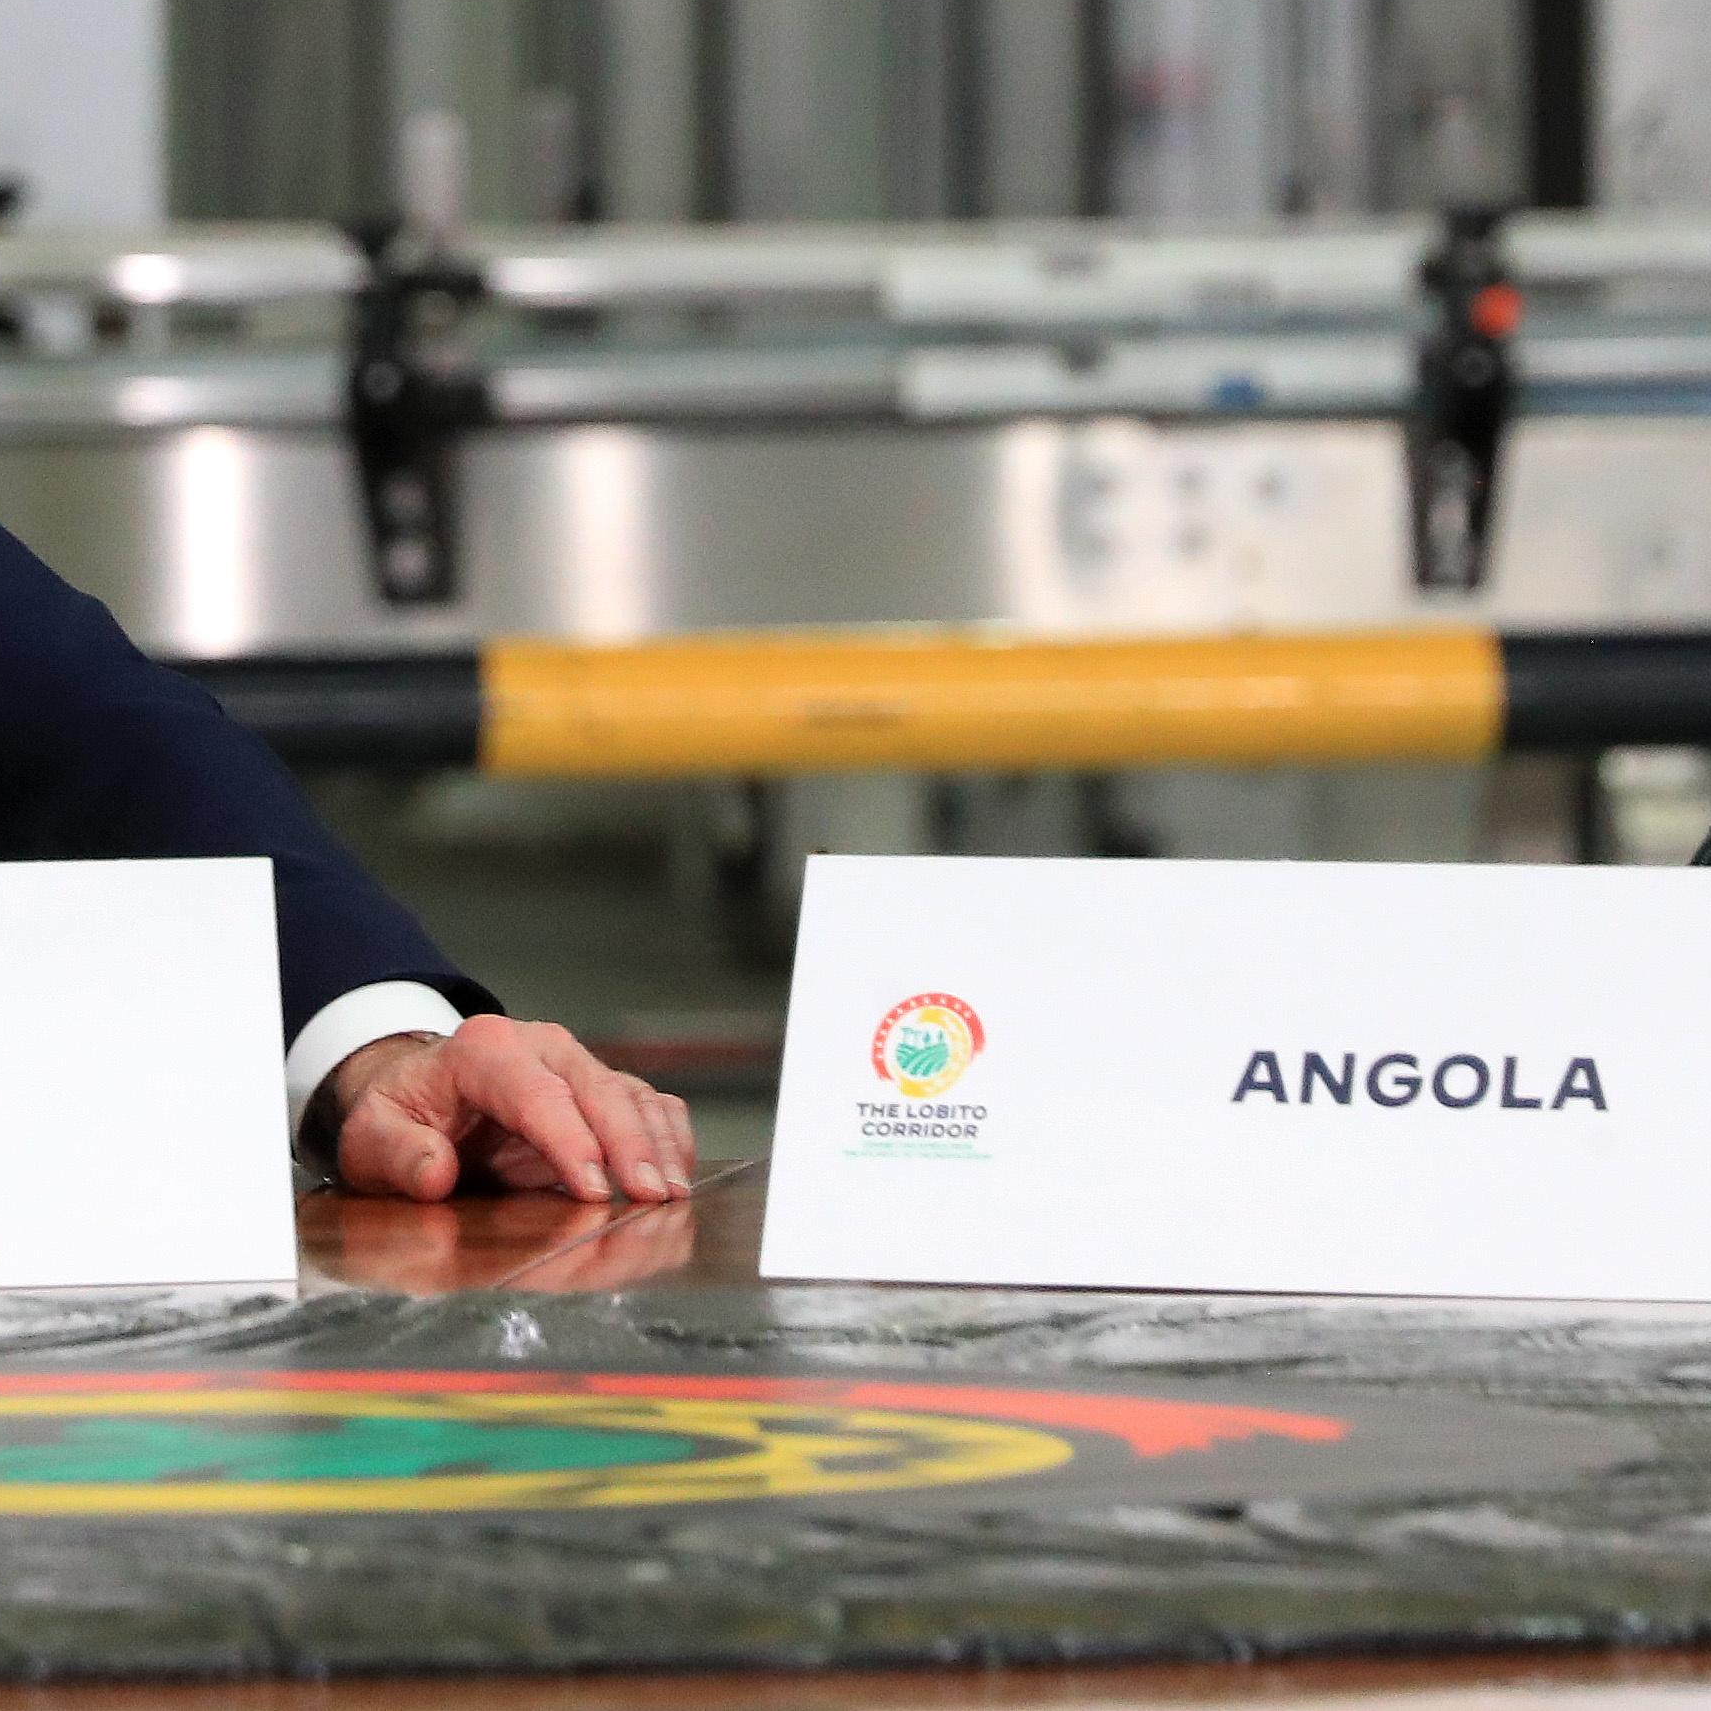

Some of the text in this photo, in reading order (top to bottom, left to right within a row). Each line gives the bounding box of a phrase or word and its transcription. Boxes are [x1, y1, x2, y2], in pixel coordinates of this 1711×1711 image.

[1232, 1050, 1609, 1112] ANGOLA
[858, 1103, 987, 1120] THE LOBITO
[862, 1122, 978, 1138] CORRIDOR
